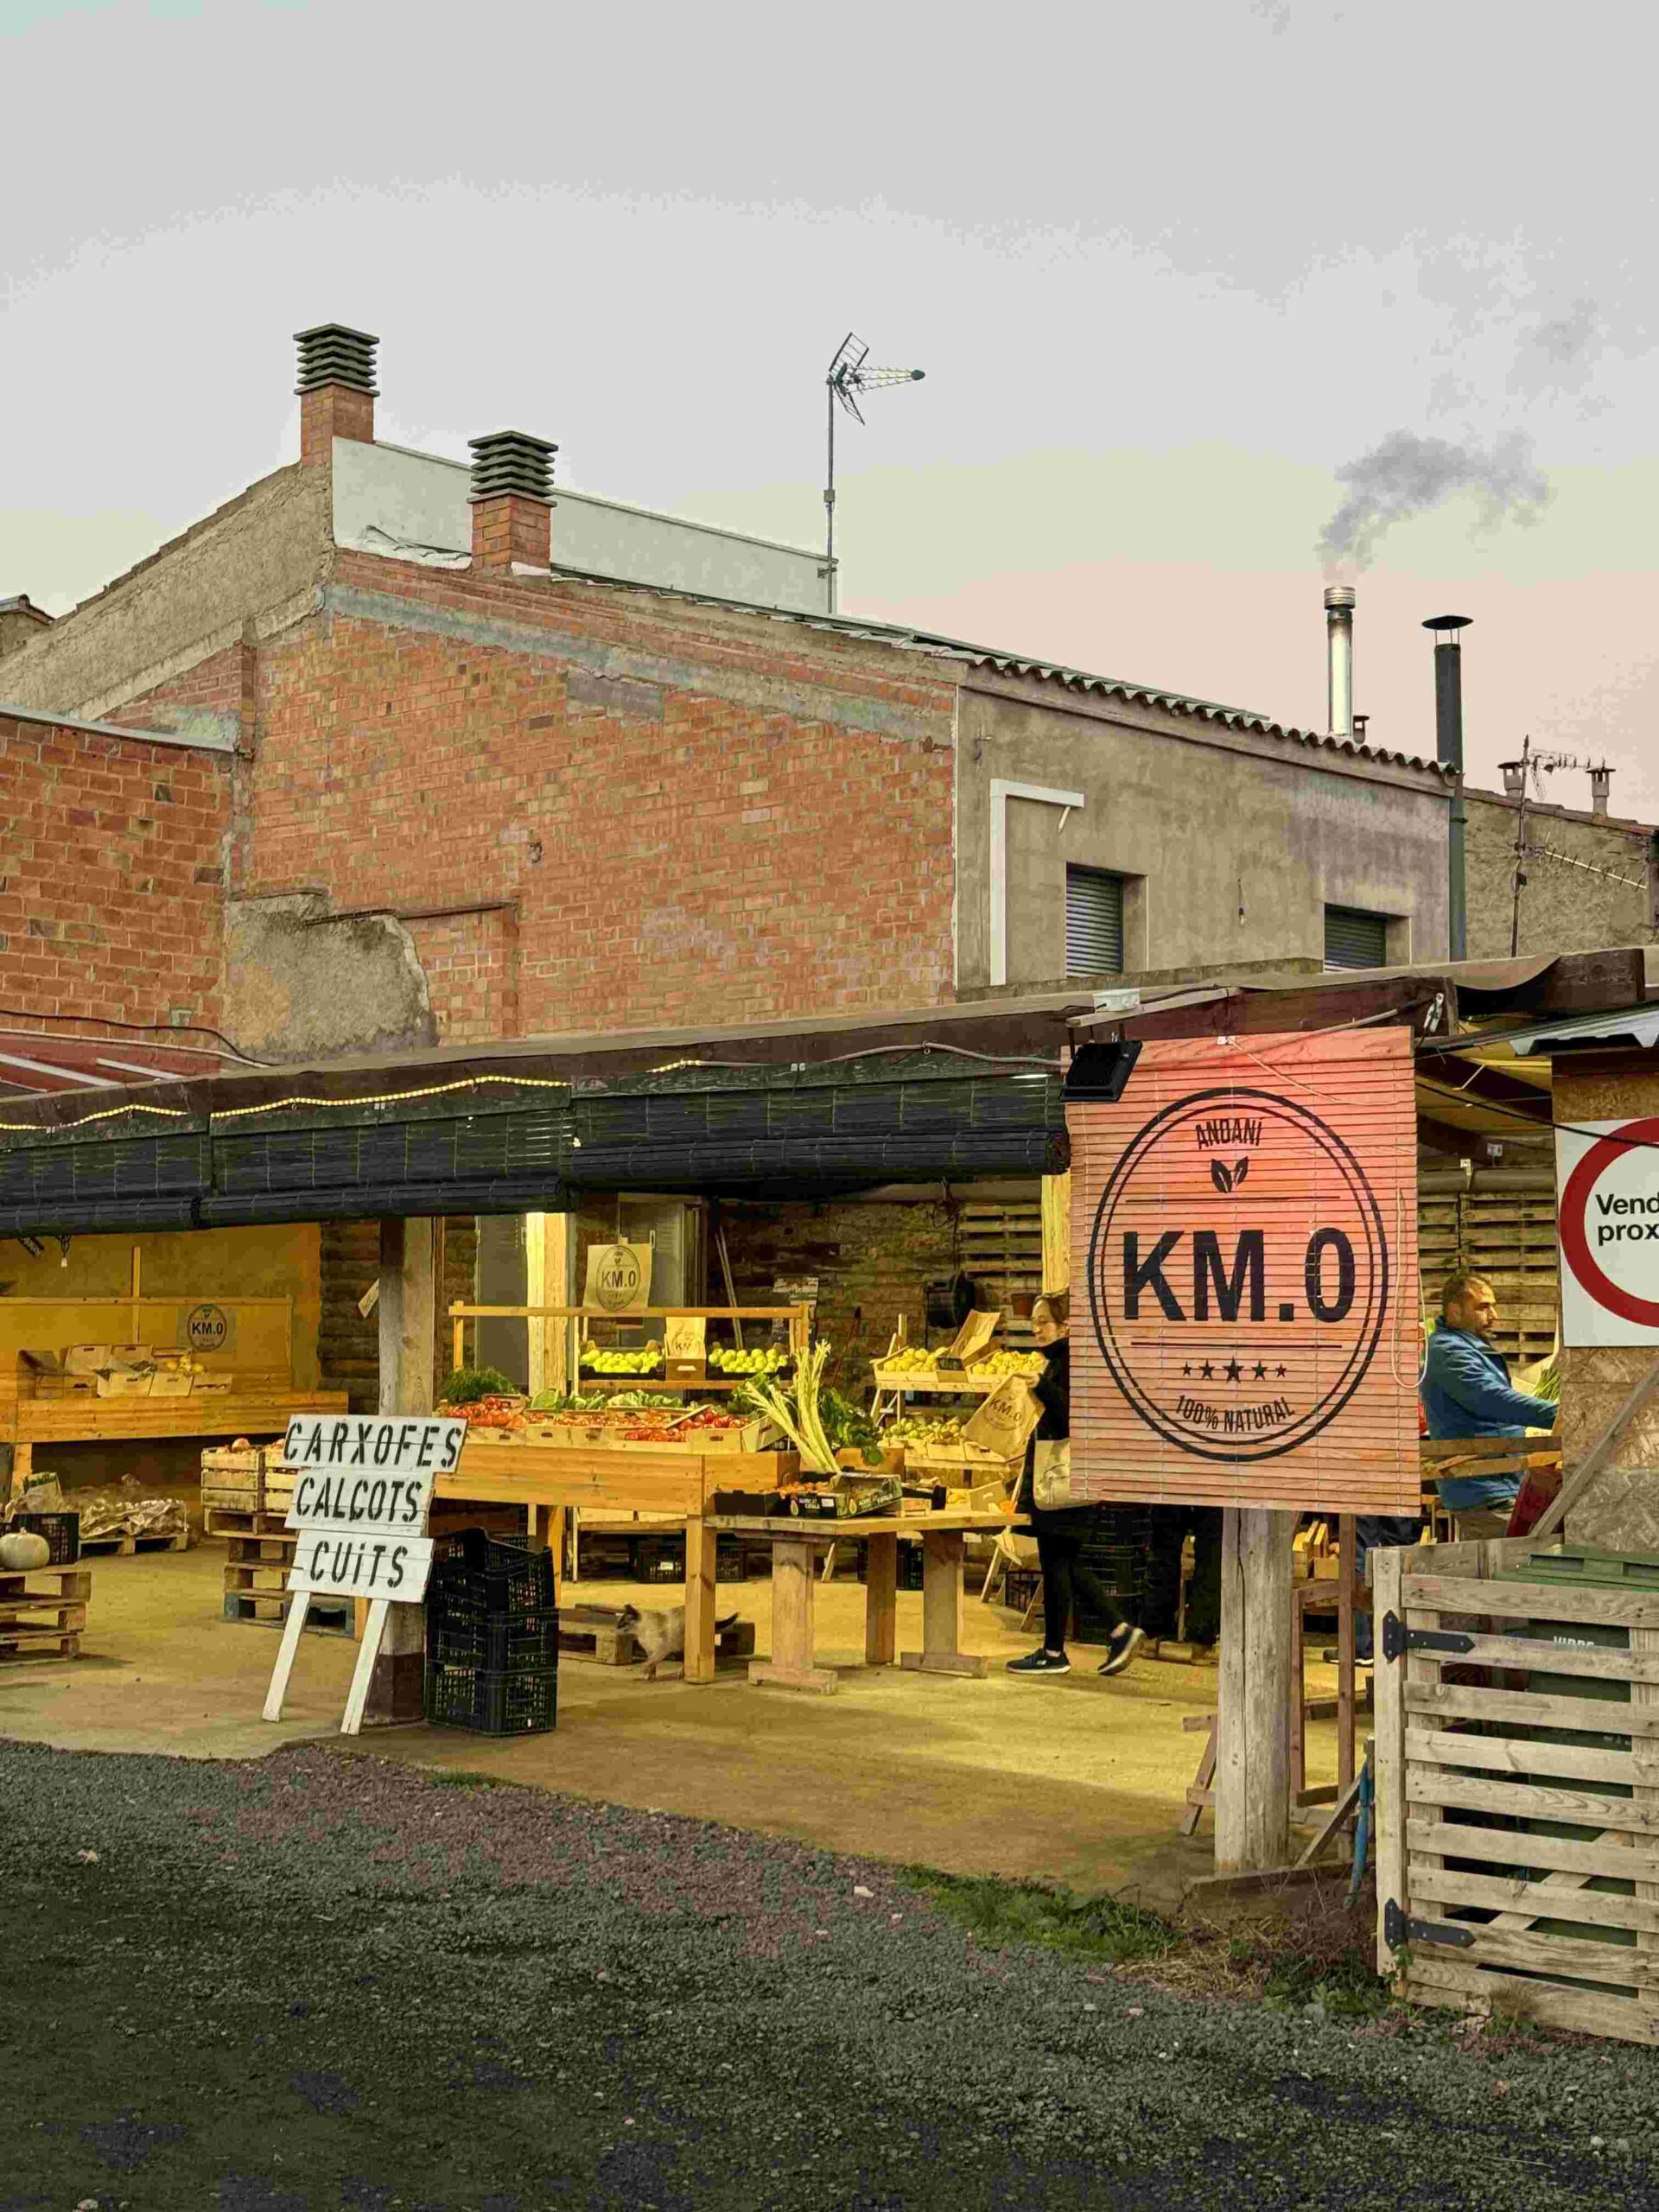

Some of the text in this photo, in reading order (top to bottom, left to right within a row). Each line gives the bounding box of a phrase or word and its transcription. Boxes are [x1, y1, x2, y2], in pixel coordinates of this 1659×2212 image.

[601, 1269, 637, 1288] KM.0
[1123, 1227, 1356, 1323] KM.0
[192, 1322, 224, 1335] KM.0
[1175, 1395, 1295, 1433] 100% NATURAL
[283, 1422, 462, 1468] CARXOFES
